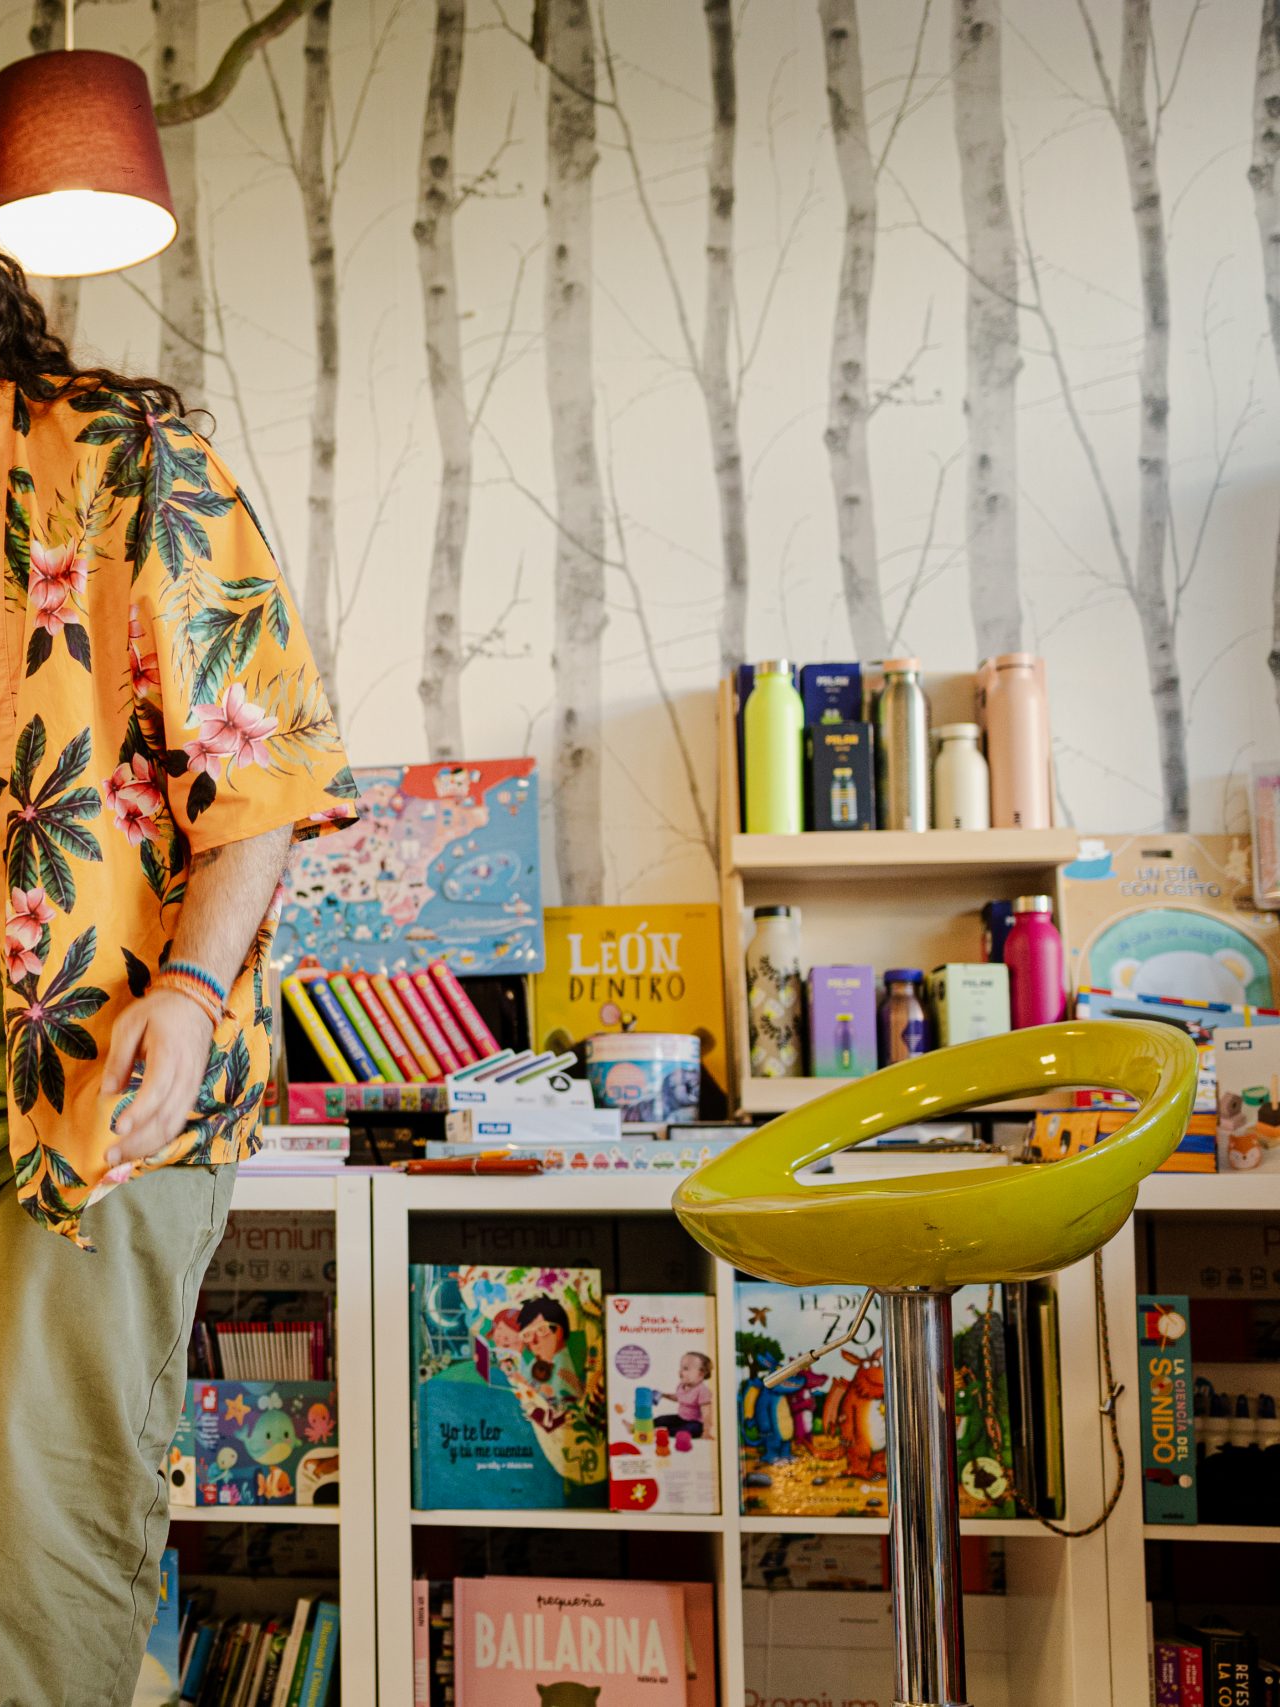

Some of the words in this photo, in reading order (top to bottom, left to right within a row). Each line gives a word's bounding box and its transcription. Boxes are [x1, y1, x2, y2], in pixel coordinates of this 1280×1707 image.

[569, 974, 686, 1002] DENTRO
[799, 1291, 825, 1310] EL
[822, 1312, 877, 1346] ZO
[1173, 1359, 1185, 1375] LA
[1149, 1358, 1176, 1464] SONIDO
[1174, 1379, 1188, 1432] CIENCIA
[462, 1424, 478, 1441] te
[480, 1419, 504, 1441] leo
[1176, 1437, 1189, 1462] DEL
[537, 1594, 605, 1612] pequeña
[474, 1610, 669, 1677] BAILARINA
[1218, 1663, 1232, 1680] LA
[1219, 1685, 1233, 1707] CO
[1235, 1663, 1250, 1706] REYES
